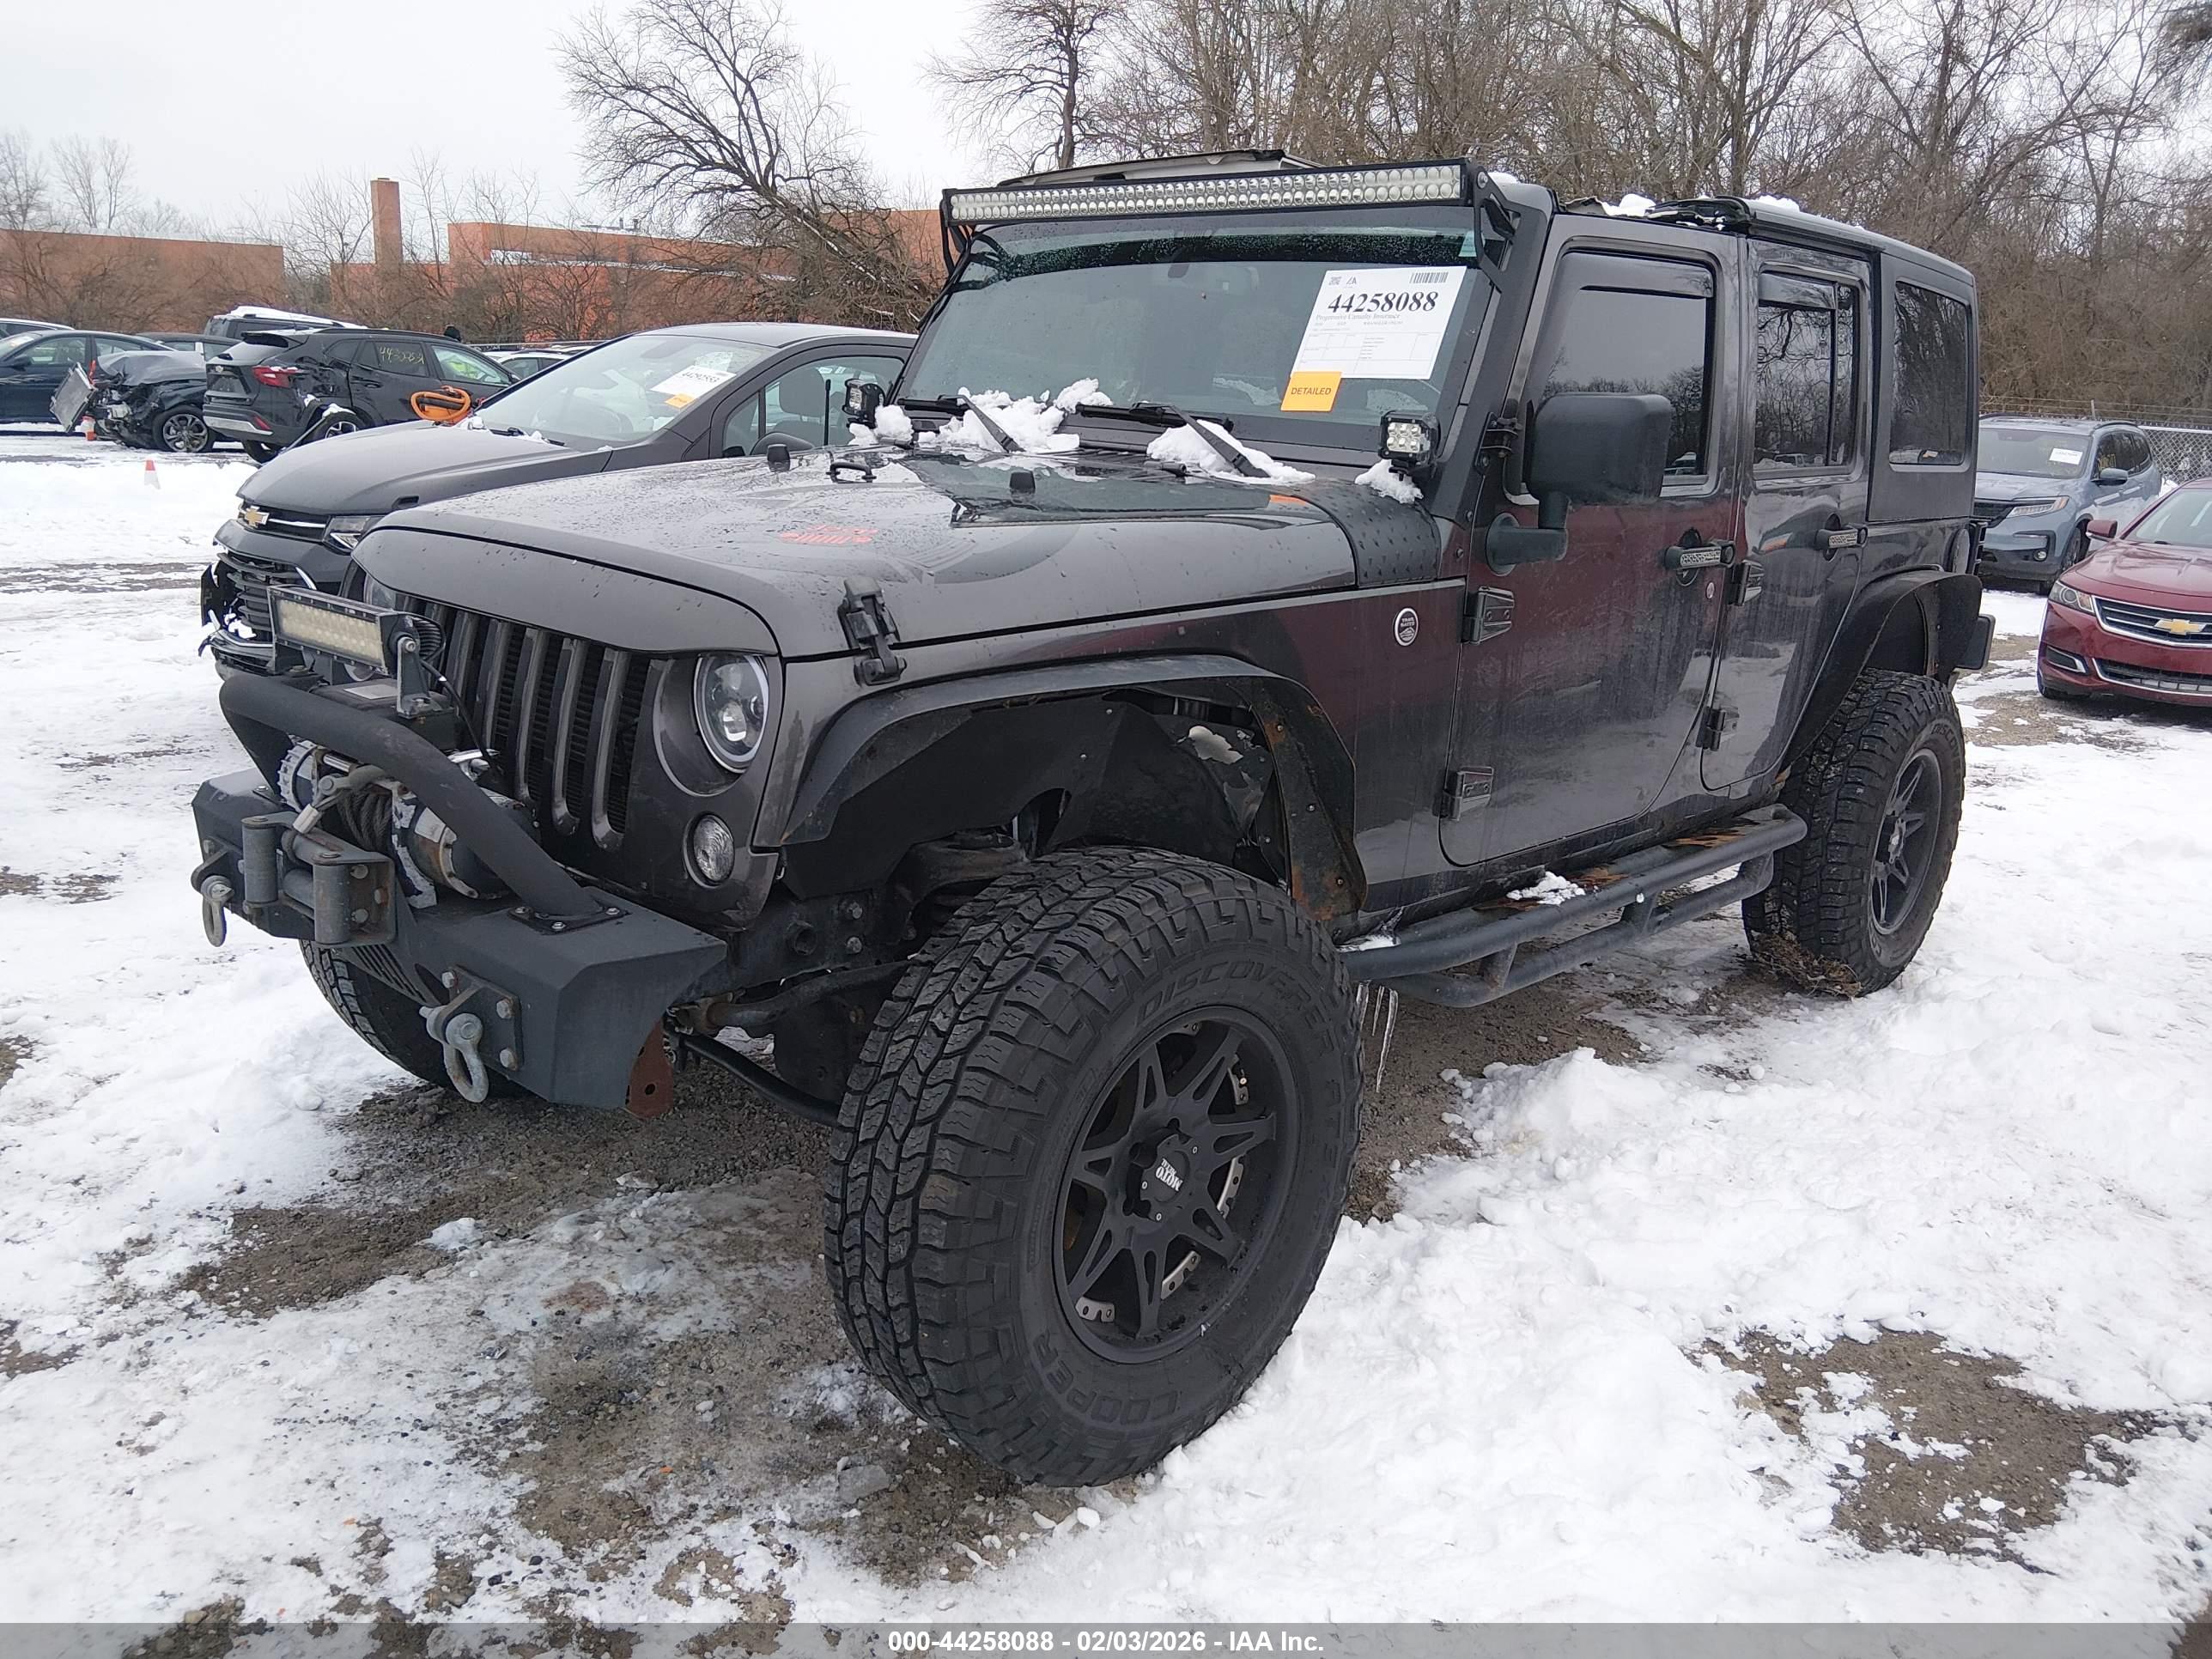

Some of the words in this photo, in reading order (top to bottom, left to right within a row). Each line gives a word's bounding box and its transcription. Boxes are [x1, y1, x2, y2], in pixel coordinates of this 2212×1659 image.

[1328, 291, 1439, 313] 44258088
[1155, 1166, 1183, 1191] MOTO
[1033, 1328, 1183, 1426] COOPER
